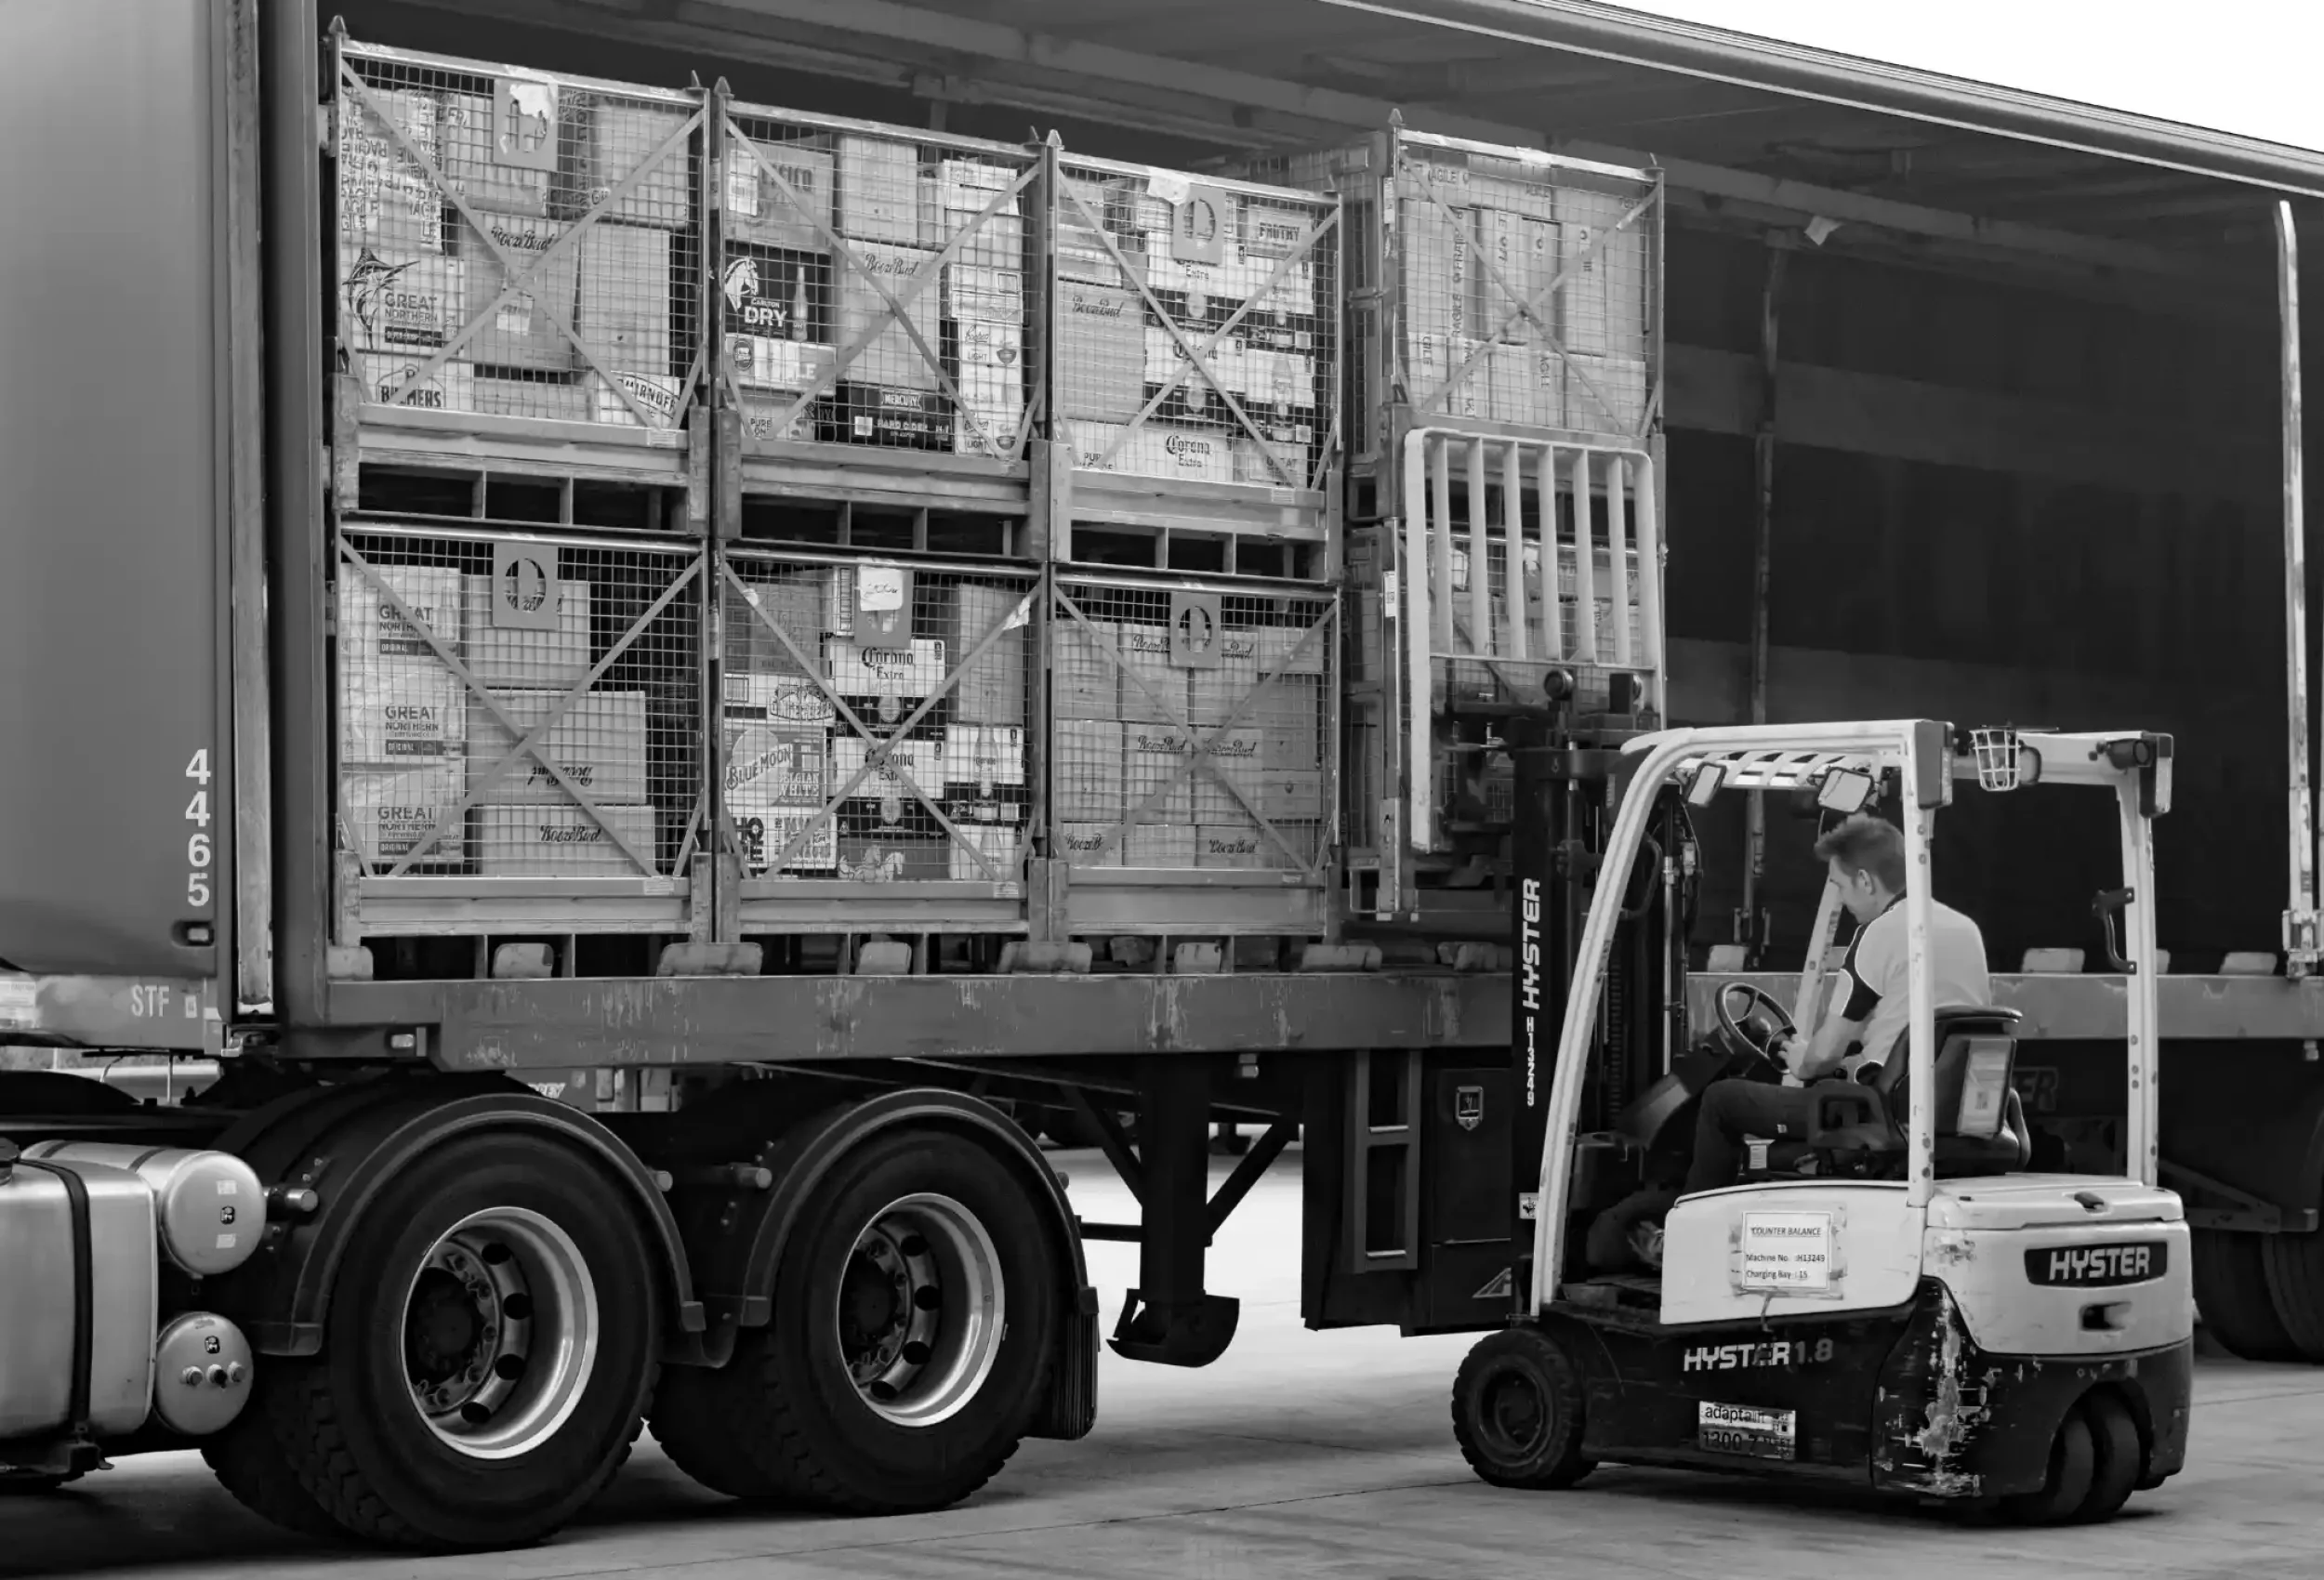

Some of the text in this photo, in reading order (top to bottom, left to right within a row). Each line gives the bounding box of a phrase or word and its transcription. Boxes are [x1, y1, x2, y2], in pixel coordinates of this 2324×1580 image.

[385, 292, 438, 311] GREAT
[751, 297, 780, 309] CARLTON
[385, 308, 438, 323] NORTHERN
[745, 306, 787, 327] DRY
[381, 385, 441, 407] BMERS
[1166, 434, 1210, 454] Corona
[1178, 454, 1202, 467] Extra
[379, 603, 433, 622] GRAT
[862, 646, 914, 668] Corona
[876, 665, 905, 680] Extra
[385, 705, 439, 720] GREAT
[385, 721, 439, 732] NORTHERN
[726, 749, 792, 791] BLUE MOON
[377, 806, 433, 820] GREAT
[186, 749, 211, 907] 4465
[1522, 878, 1540, 1010] HYSTER
[131, 984, 170, 1017] STF
[1526, 1017, 1536, 1107] H13249
[1751, 1227, 1822, 1237] COUNTER BALANCE
[1746, 1254, 1776, 1262] Machine
[2049, 1245, 2151, 1281] HYSTER
[1747, 1270, 1776, 1280] Charging
[1777, 1270, 1791, 1280] Bay
[1799, 1271, 1808, 1279] 15
[1684, 1337, 1834, 1372] HYSTER 1.8
